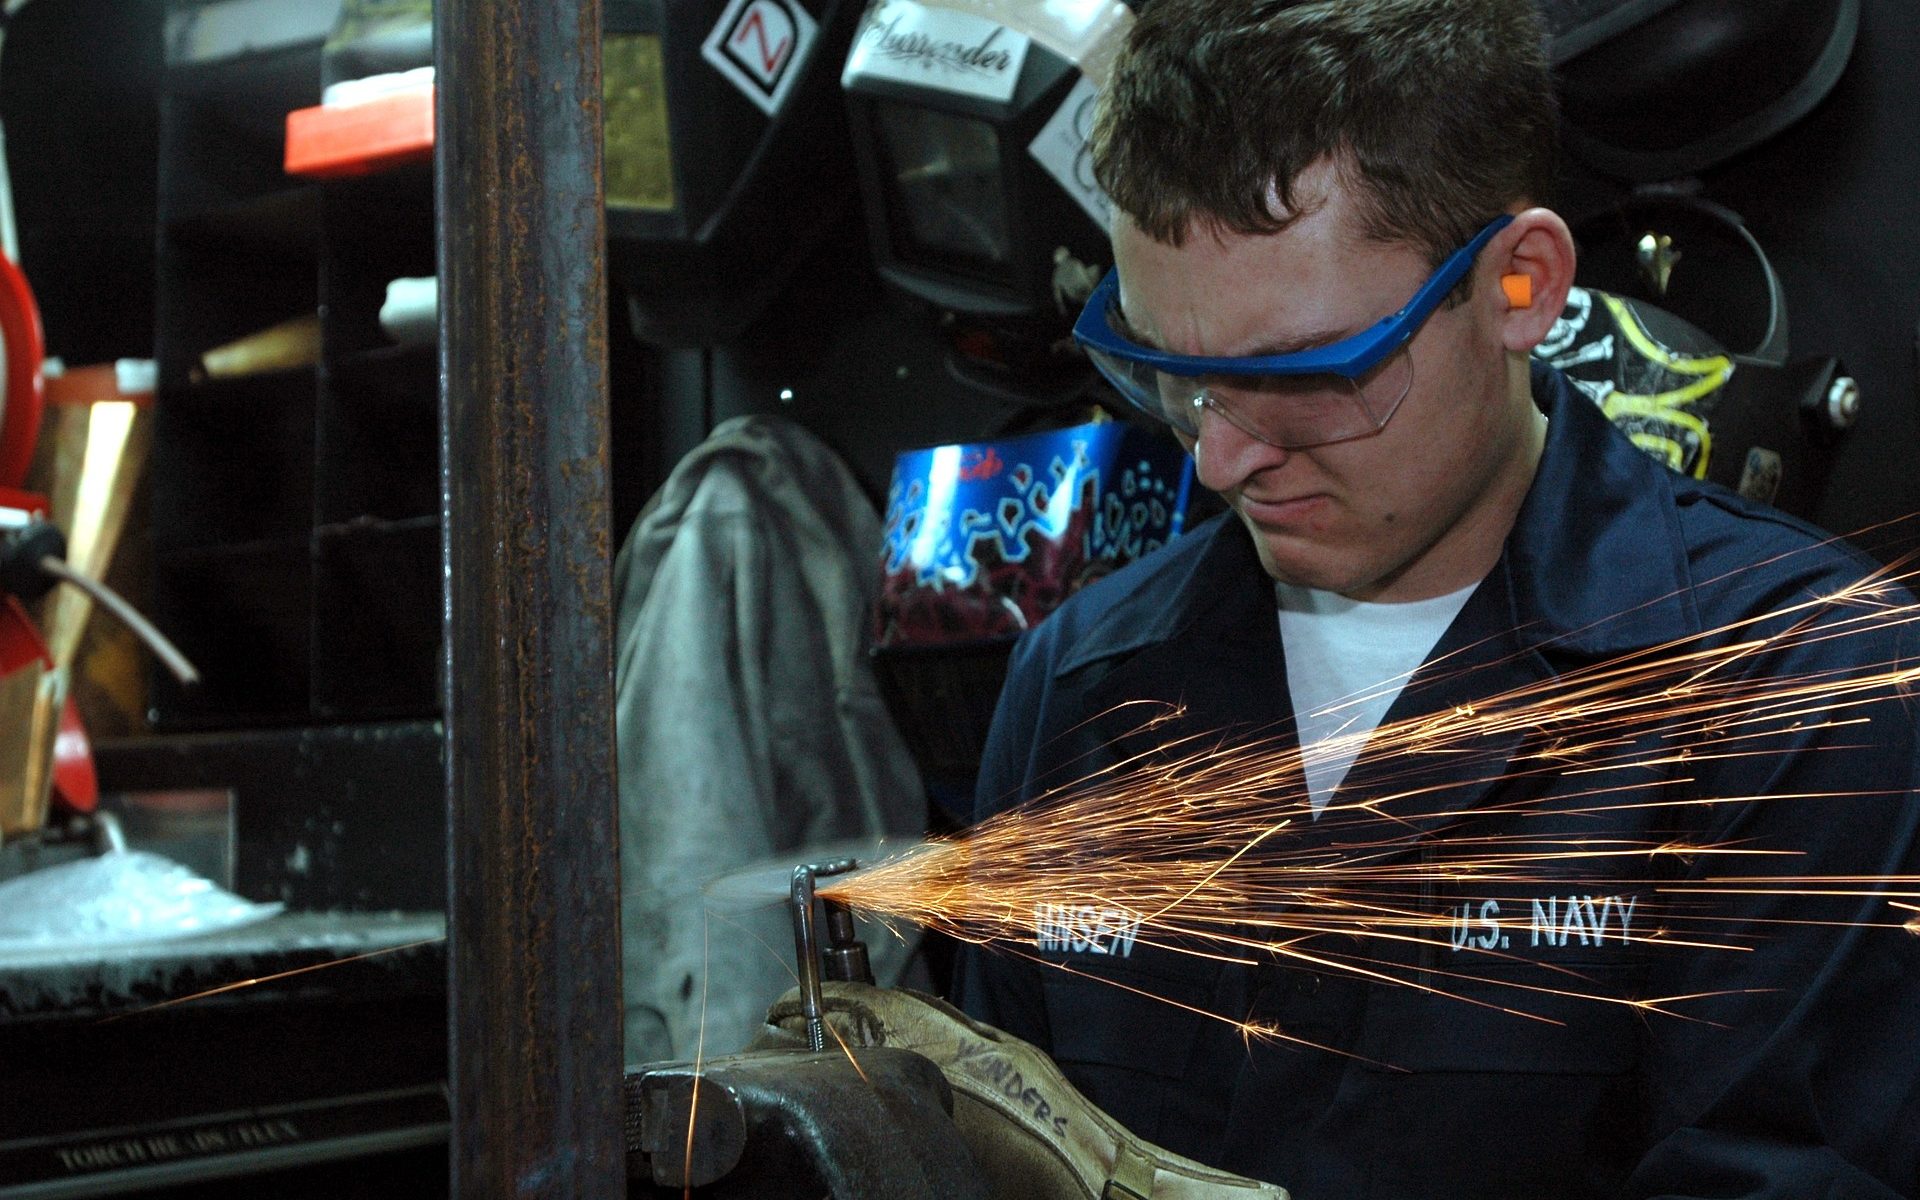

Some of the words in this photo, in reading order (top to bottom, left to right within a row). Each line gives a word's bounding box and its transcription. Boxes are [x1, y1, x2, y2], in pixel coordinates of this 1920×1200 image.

[1452, 898, 1509, 952] U.S.
[1531, 895, 1638, 947] NAVY
[55, 1139, 147, 1170] TORCH
